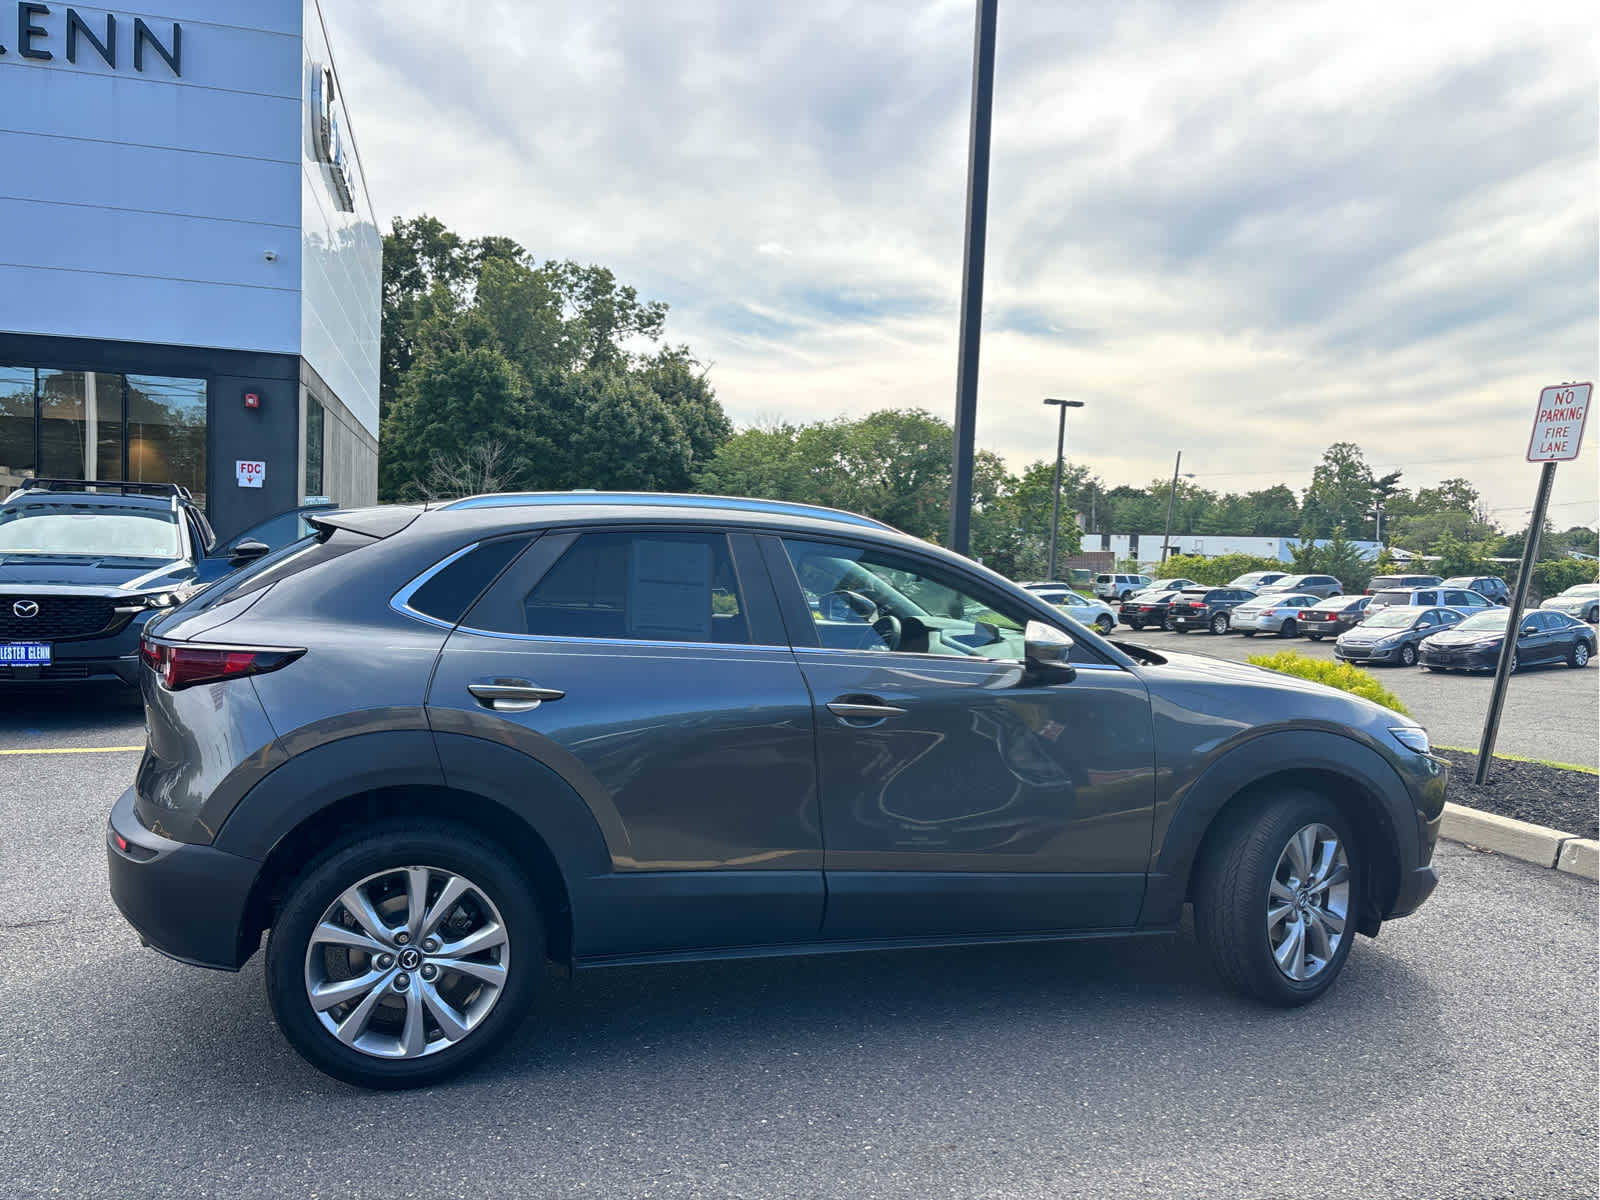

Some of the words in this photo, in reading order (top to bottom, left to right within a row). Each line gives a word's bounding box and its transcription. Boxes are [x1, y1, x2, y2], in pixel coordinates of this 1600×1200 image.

[0, 1, 182, 77] ENN
[1554, 391, 1575, 405] NO
[1539, 406, 1583, 422] PARKING
[1545, 426, 1569, 439] FIRE
[1540, 441, 1568, 453] LANE
[241, 463, 262, 474] FDC
[0, 647, 25, 660] LESTER
[28, 647, 50, 660] GLENN
